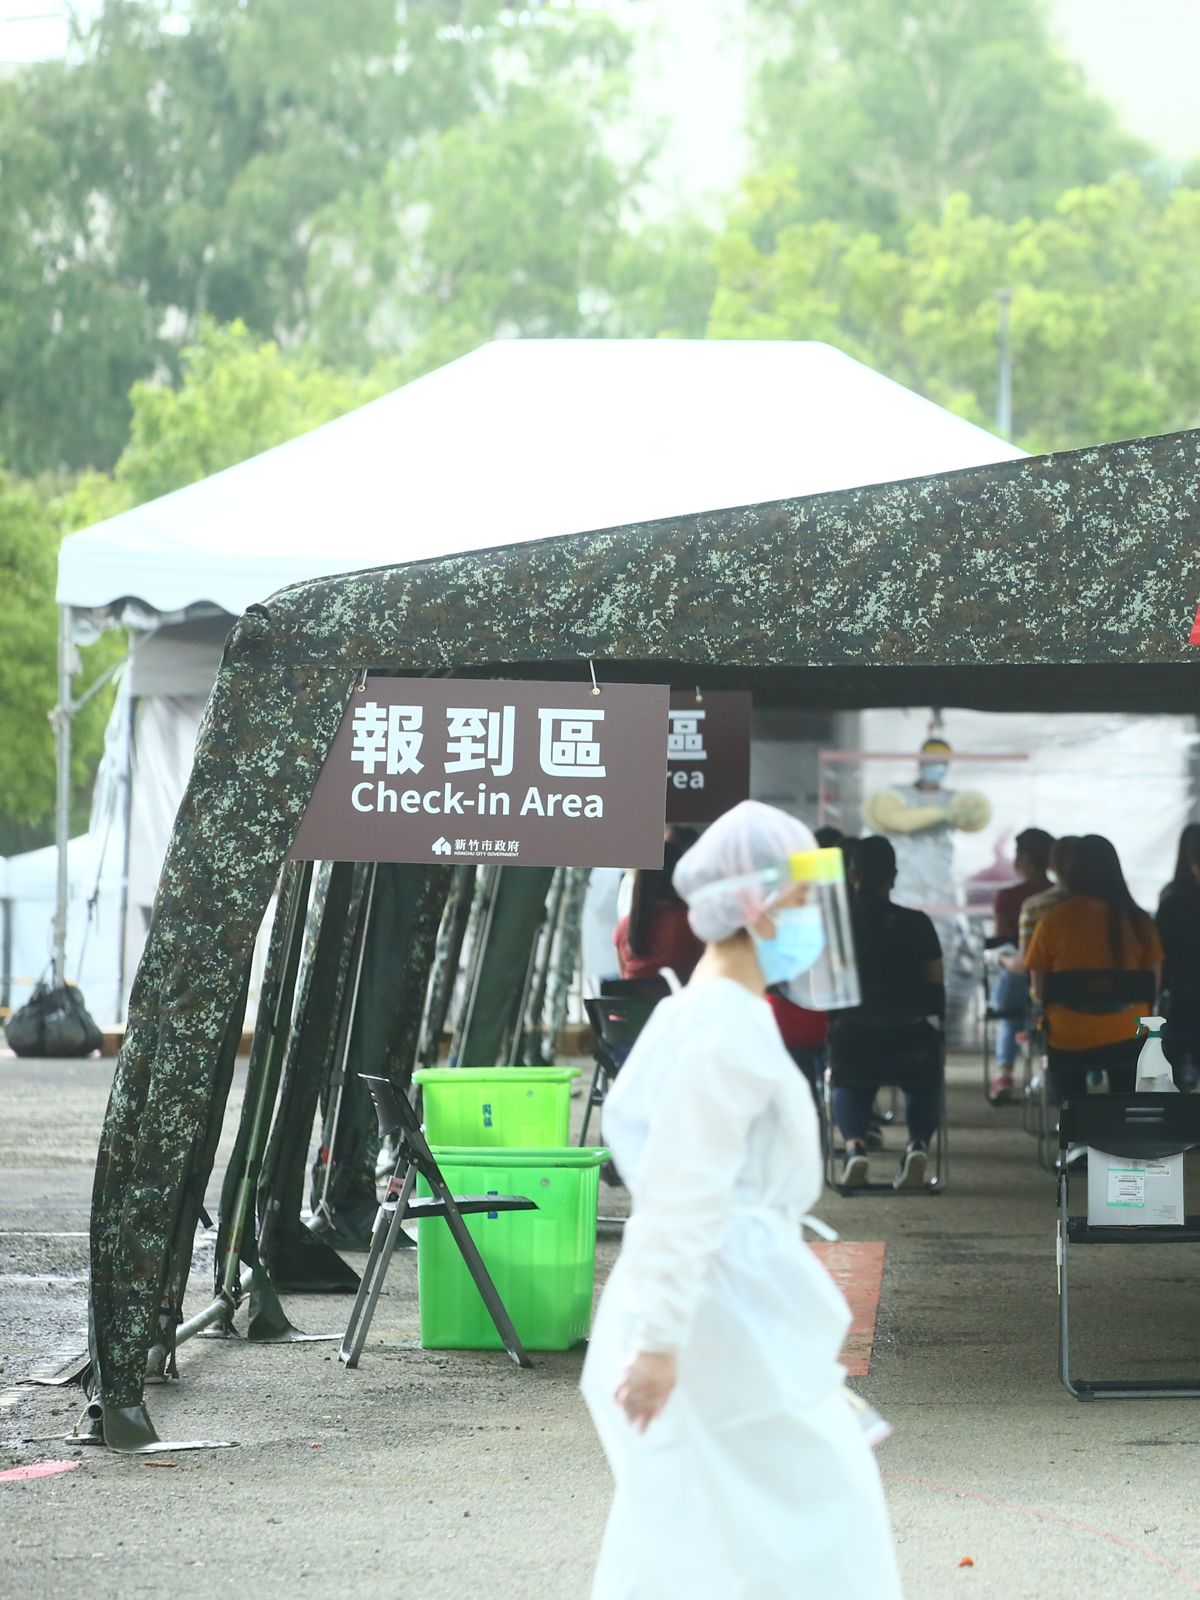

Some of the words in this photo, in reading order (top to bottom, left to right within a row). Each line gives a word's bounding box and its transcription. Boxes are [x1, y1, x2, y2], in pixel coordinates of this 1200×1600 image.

[350, 701, 607, 778] 報到區
[351, 780, 510, 817] Check-in
[519, 786, 605, 818] Area
[454, 838, 520, 852] 新竹市政府
